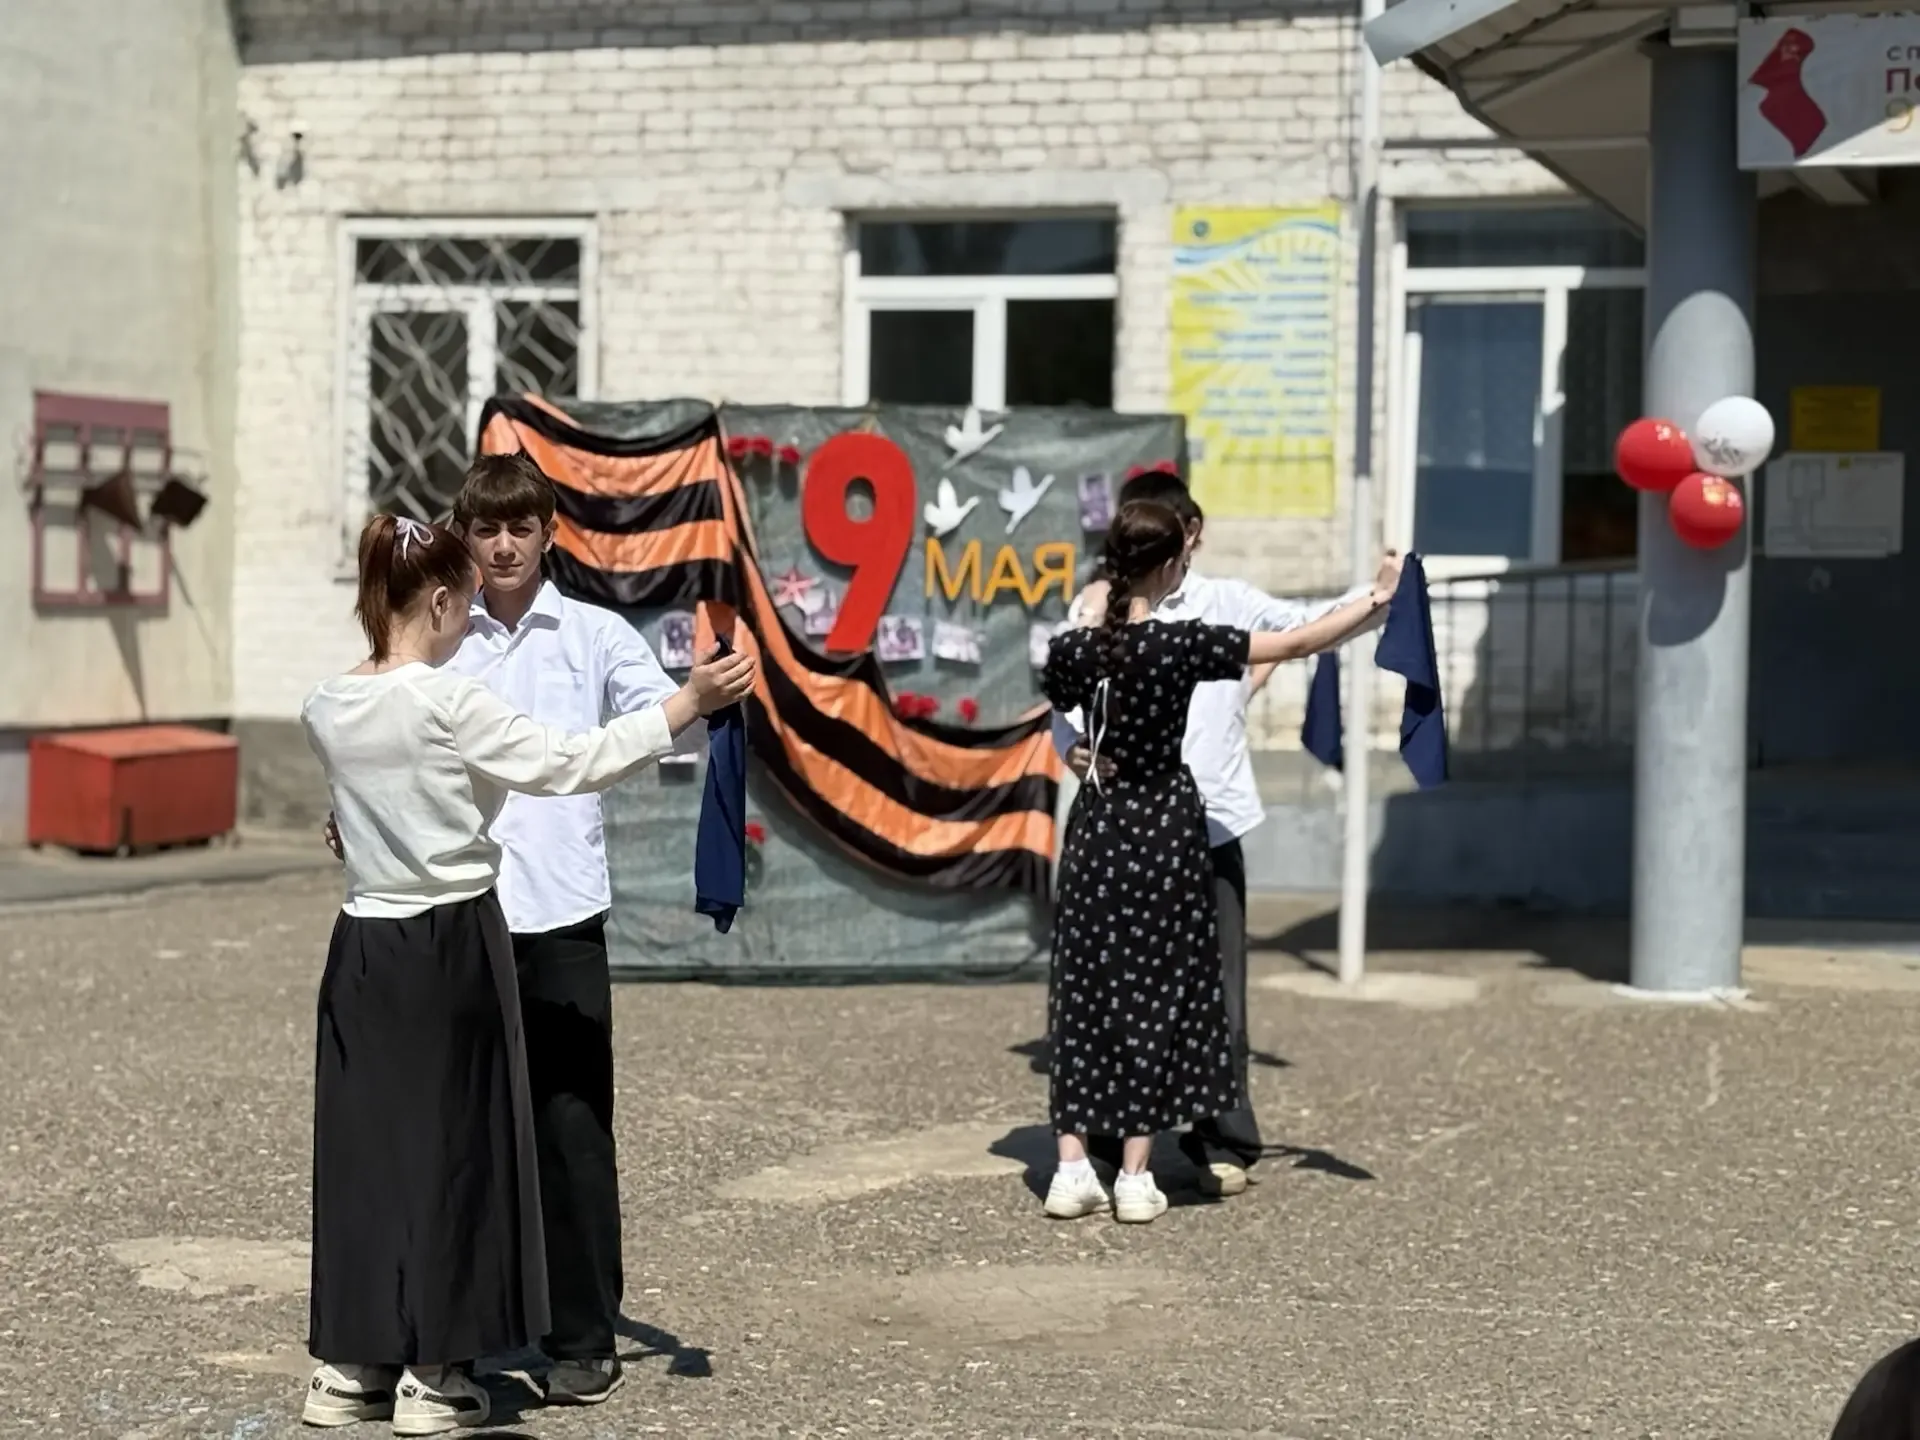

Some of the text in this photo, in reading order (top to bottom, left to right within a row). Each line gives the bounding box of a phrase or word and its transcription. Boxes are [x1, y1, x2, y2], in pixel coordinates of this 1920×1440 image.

[1886, 98, 1914, 133] 9
[803, 431, 1075, 653] 9 МАЯ
